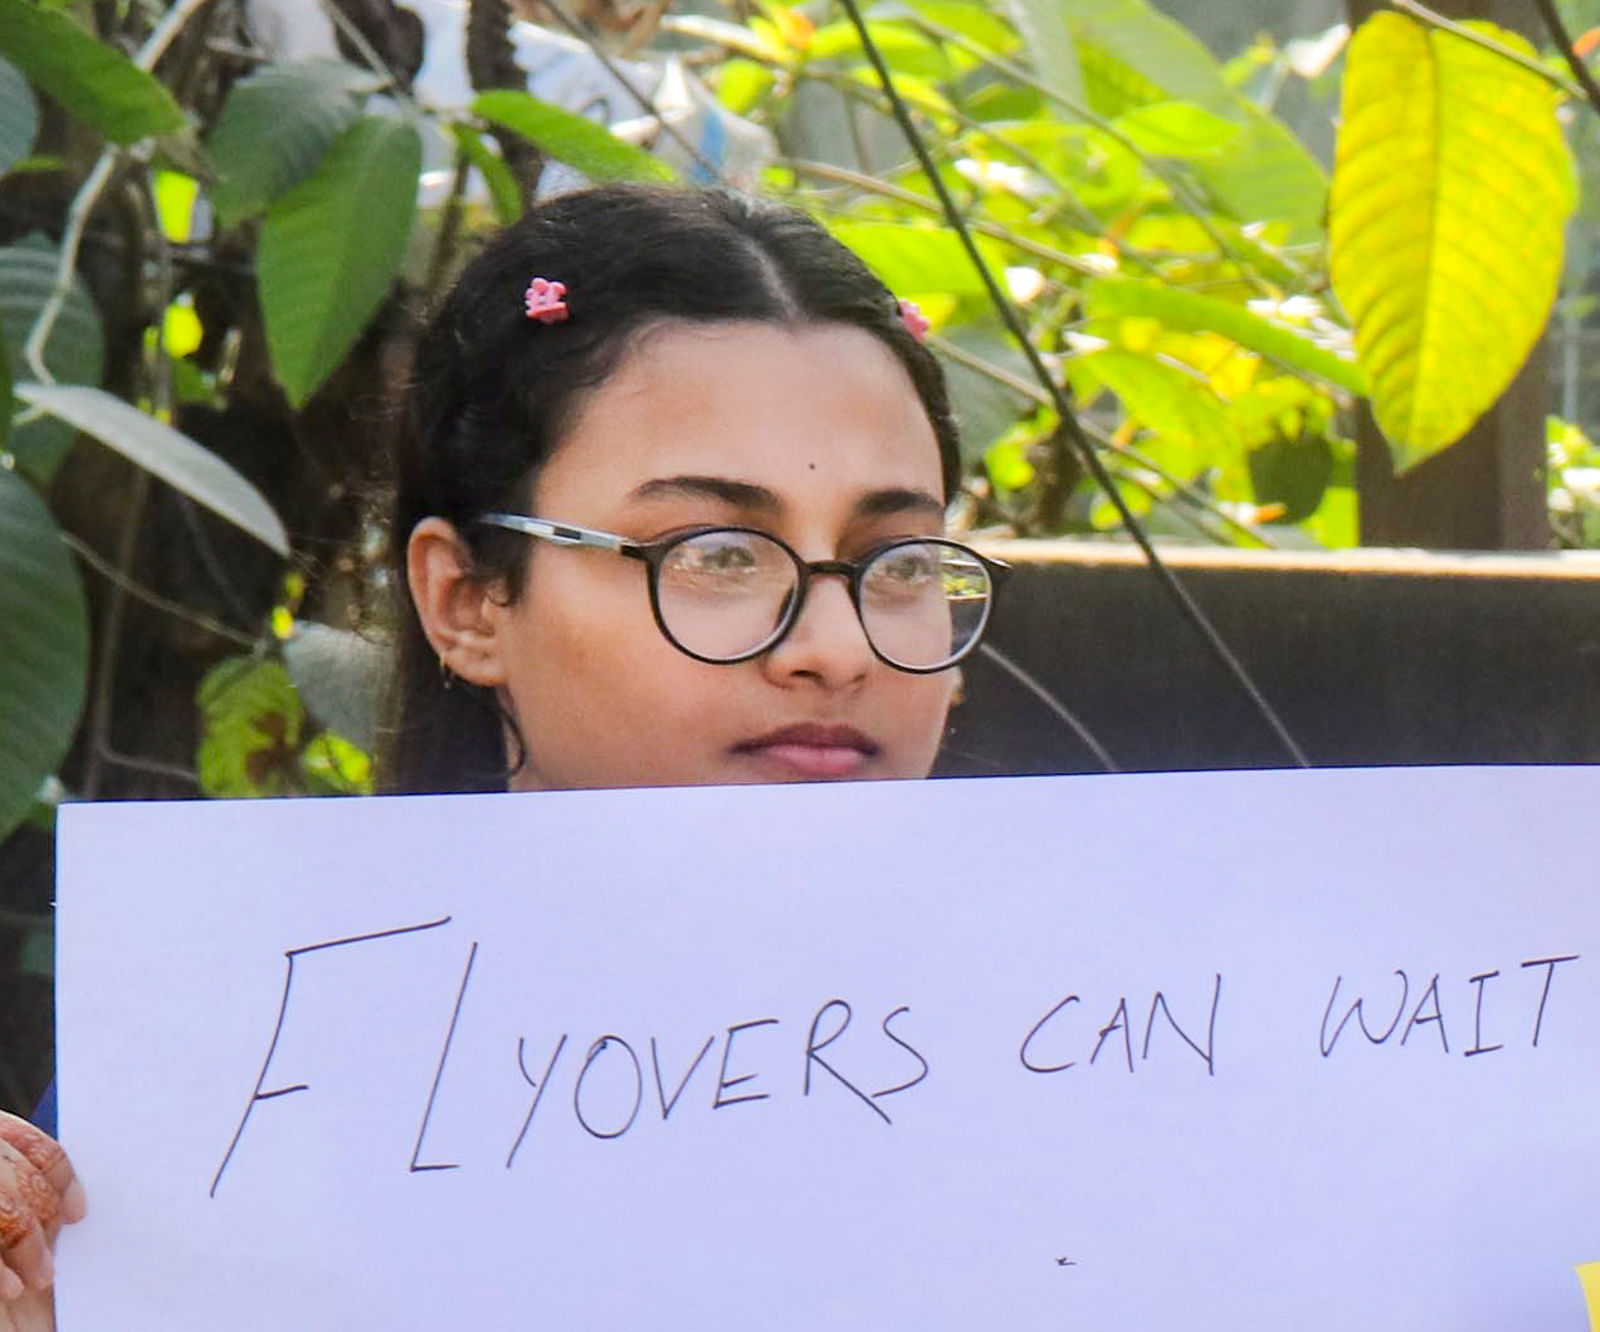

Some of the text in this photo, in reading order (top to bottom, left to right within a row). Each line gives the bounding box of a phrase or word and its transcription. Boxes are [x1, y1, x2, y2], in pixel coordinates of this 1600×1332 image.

[210, 916, 929, 1198] FLYOVERS
[1020, 973, 1222, 1077] CAN
[1320, 955, 1579, 1060] WAIT
